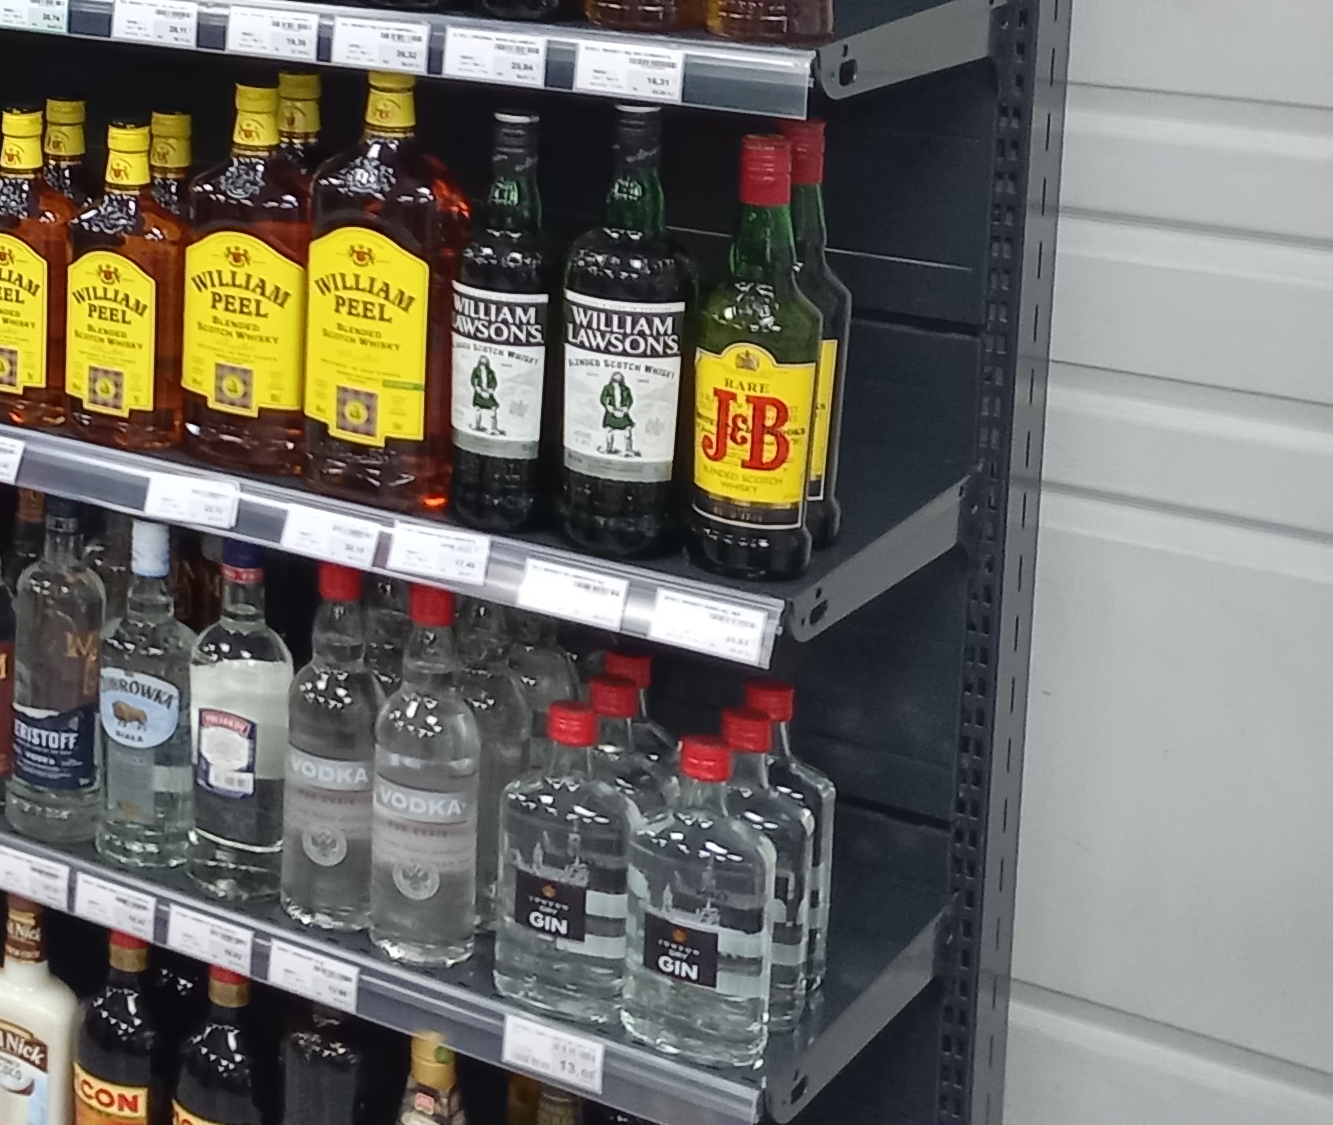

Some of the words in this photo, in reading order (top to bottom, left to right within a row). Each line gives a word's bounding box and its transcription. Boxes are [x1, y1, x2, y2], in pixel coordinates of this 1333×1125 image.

[72, 285, 148, 318] WILLIAM
[191, 269, 292, 309] WILLIAM
[314, 272, 416, 314] WILLIAM
[88, 303, 132, 325] PEEL
[210, 291, 269, 319] PEEL
[334, 294, 392, 324] PEEL
[453, 294, 536, 325] WILLIAM
[452, 313, 544, 344] AWSON'S
[571, 306, 675, 336] WILLIAM
[567, 323, 680, 356] LAWSON'S
[476, 344, 505, 357] SCOTCH
[507, 350, 539, 366] WHISKY
[603, 359, 641, 372] SCOTCH
[643, 363, 676, 379] WHISKY
[724, 377, 770, 394] RARE
[702, 387, 790, 473] J&B
[721, 481, 759, 494] WHISKY
[740, 473, 784, 485] SCOTCH
[14, 719, 79, 750] ERISTOFF
[291, 756, 368, 784] VODKA
[381, 788, 462, 815] VODKA
[529, 911, 568, 934] GIN
[658, 955, 699, 981] GIN
[5, 1031, 45, 1065] Nick
[81, 1078, 139, 1113] CON
